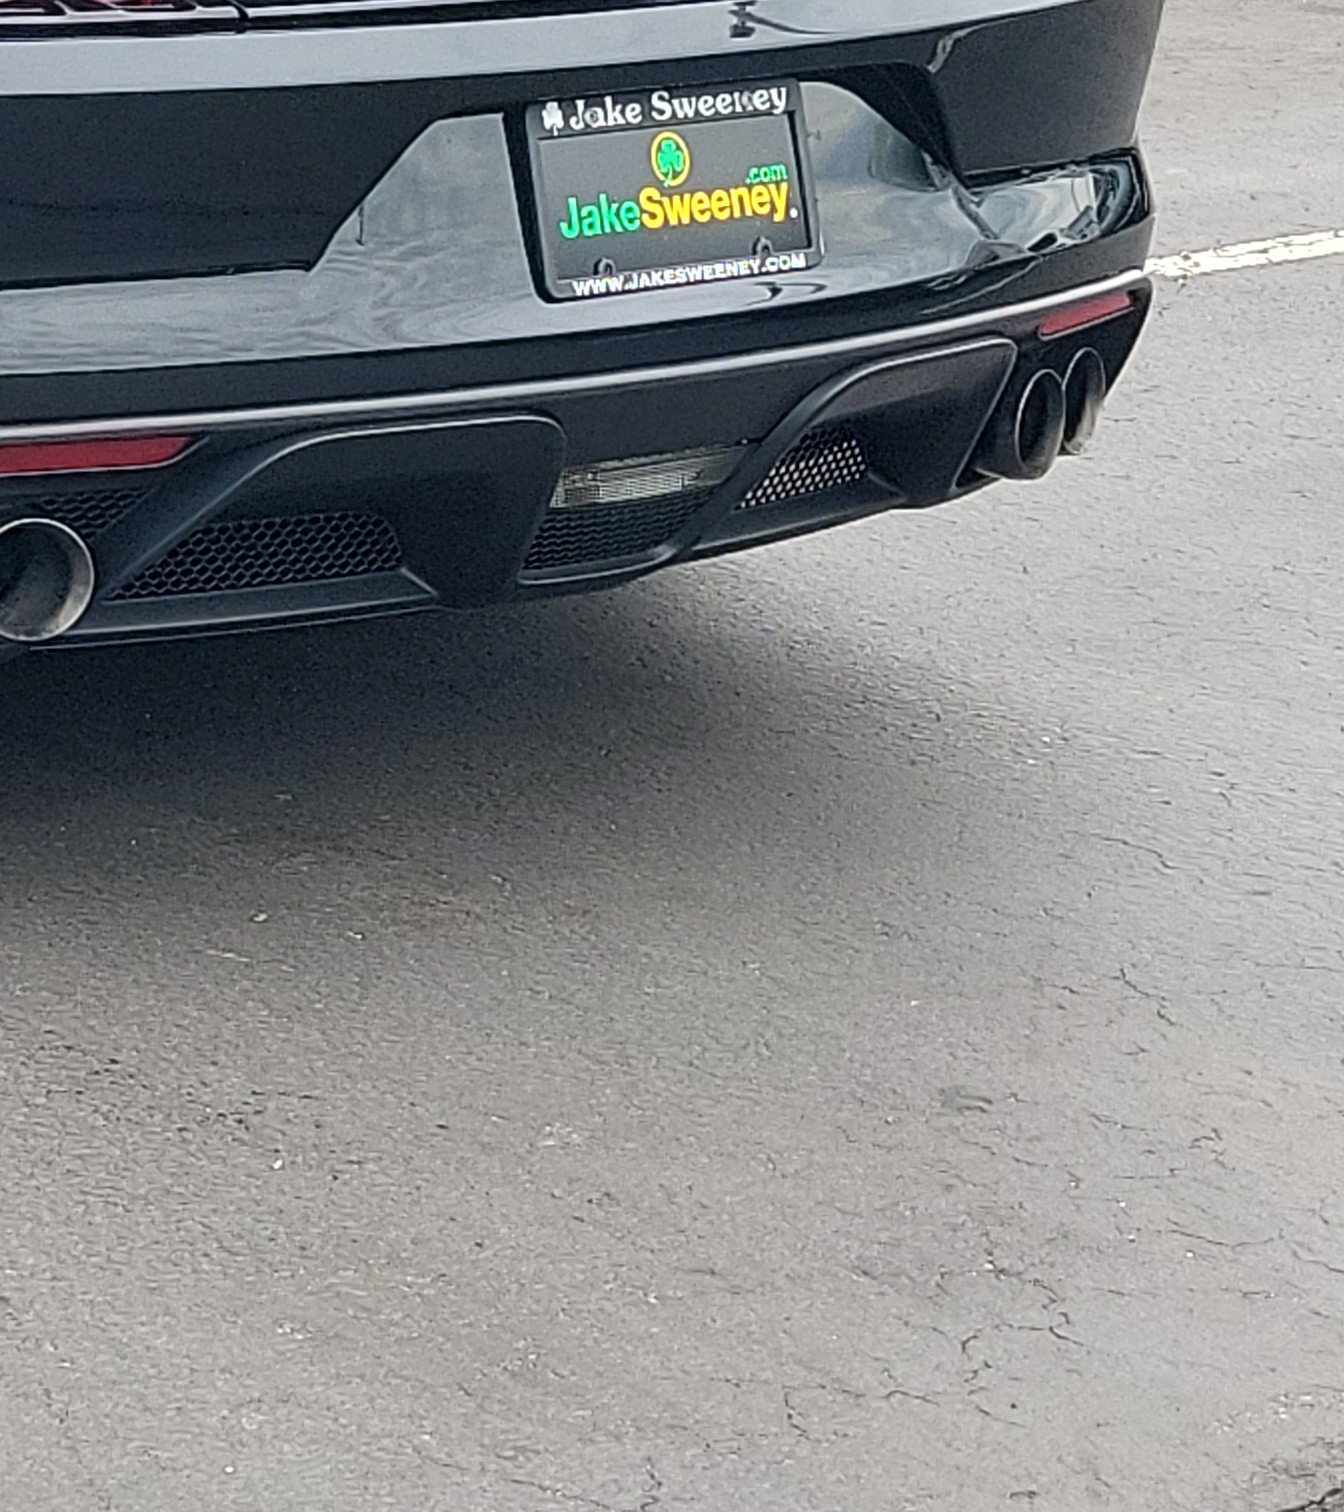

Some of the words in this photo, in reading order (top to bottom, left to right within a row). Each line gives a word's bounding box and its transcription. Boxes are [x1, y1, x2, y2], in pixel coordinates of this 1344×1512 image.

[569, 95, 643, 131] Jake
[650, 86, 788, 120] Sweeney
[571, 251, 807, 297] WWW.JAKESWEENEY.COM
